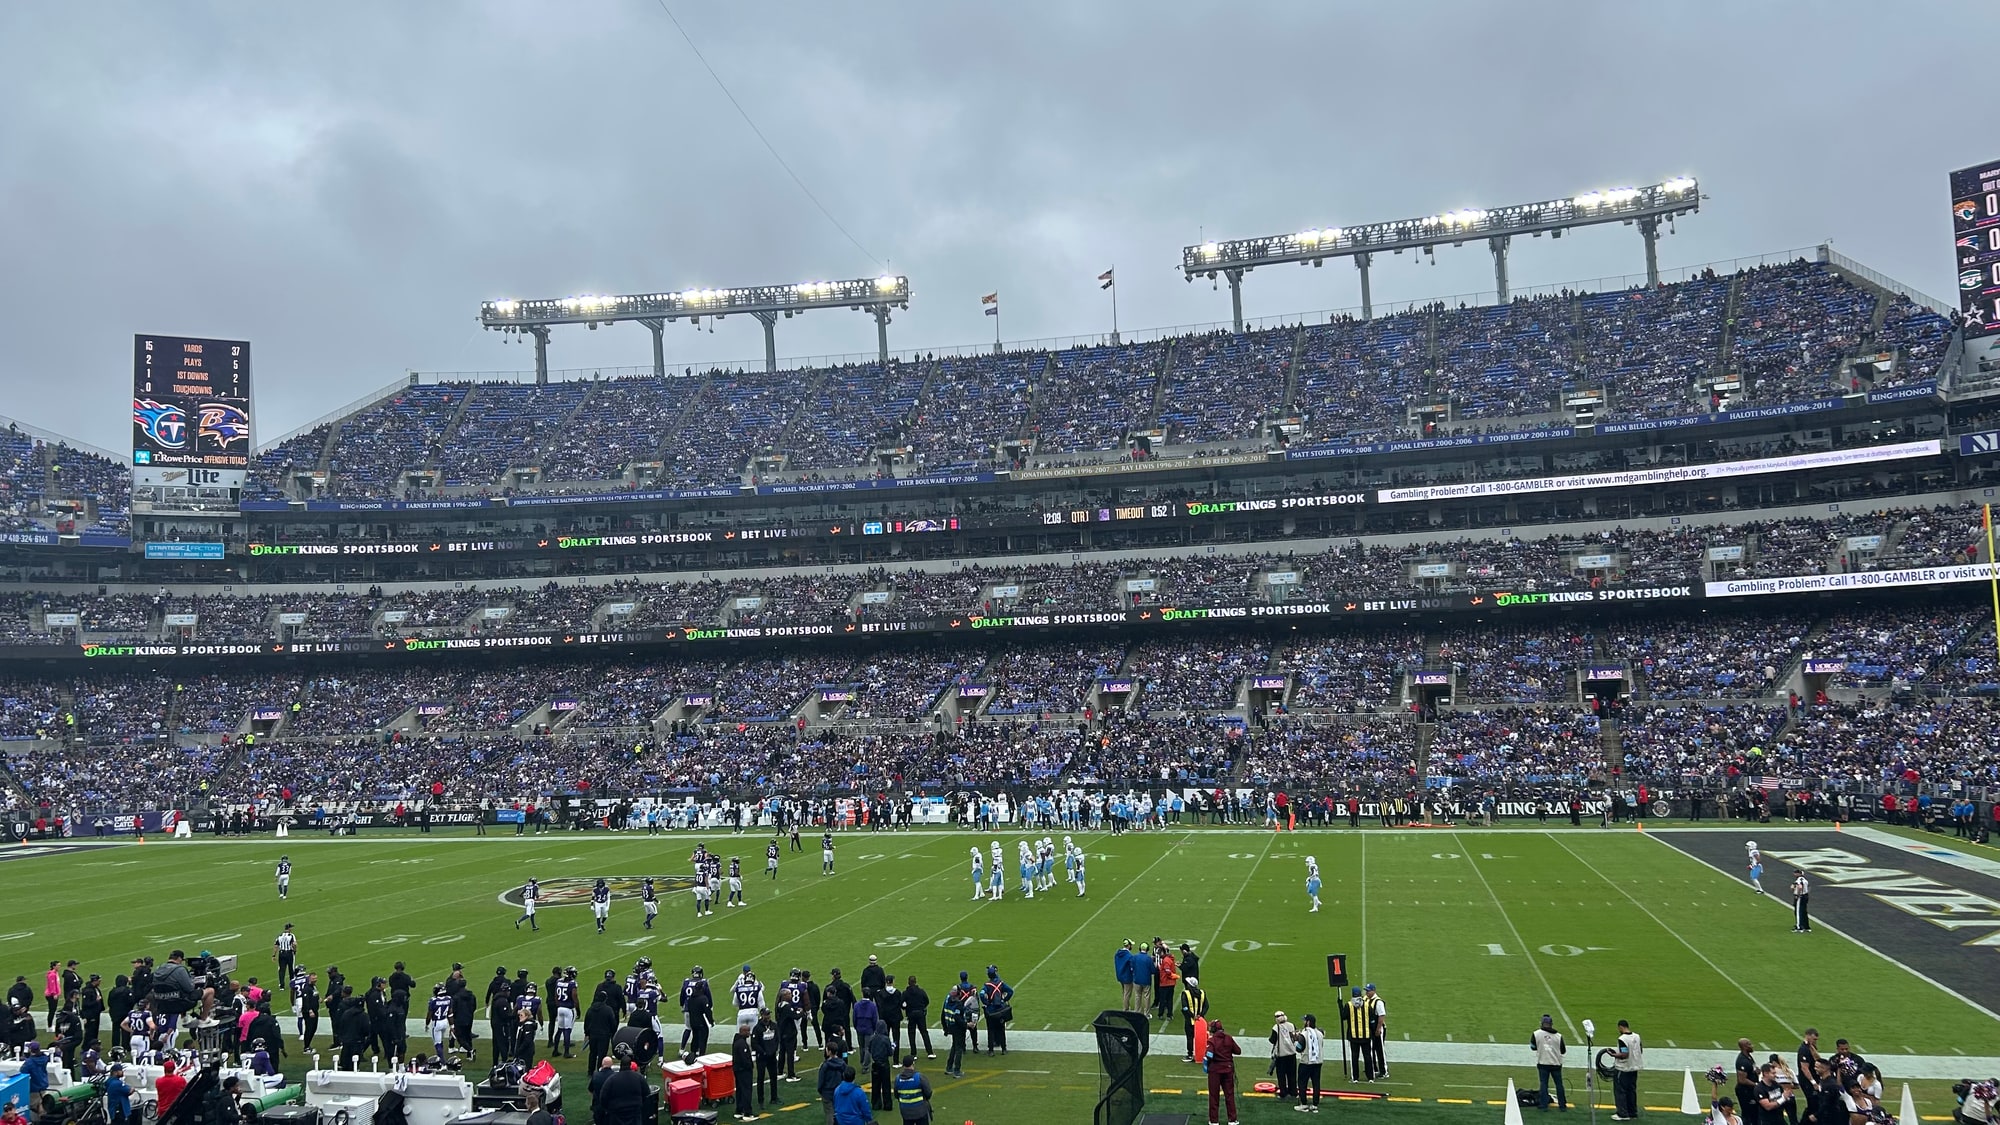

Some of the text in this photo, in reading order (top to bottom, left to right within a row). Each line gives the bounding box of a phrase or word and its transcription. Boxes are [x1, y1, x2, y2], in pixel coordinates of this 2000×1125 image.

[145, 341, 240, 356] 15 YARDS 37
[146, 355, 238, 369] 2 PLAYS 5
[147, 368, 238, 383] 1 1ST DOWNS 2
[146, 382, 238, 397] 0 TOUCHDOWNS 1
[1871, 386, 1933, 402] RING HONOR
[1729, 401, 1833, 420] HALOTI NGATA 2006-2014
[1604, 417, 1699, 433] BRIAN BILLICK 1999-2007
[1488, 429, 1570, 443] TODD HEAP 2001-2010
[1310, 449, 1336, 457] STOVER
[1337, 446, 1372, 455] 1996-2008
[1389, 438, 1473, 451] JAMAL LEWIS 2000-2006
[203, 455, 248, 465] OFFENSIVE TOTALS
[1134, 463, 1155, 471] LEWIS
[1156, 460, 1190, 470] 1996-2012
[186, 468, 220, 486] Lite
[1020, 466, 1110, 479] JONATHAN OGDEN 1996-2007
[798, 484, 824, 492] McCRARY
[912, 477, 946, 485] BOULWARE
[1390, 488, 1429, 500] Gambling
[1430, 486, 1468, 497] Problem?
[1470, 484, 1486, 494] Call
[1488, 479, 1554, 493] 1-800-GAMBLER
[1556, 479, 1566, 487] or
[1567, 475, 1585, 486] visit
[431, 501, 451, 509] BYNER
[452, 500, 482, 508] 1996-2003
[1187, 494, 1365, 515] DRAFTKINGS SPORTSBOOK
[1043, 513, 1062, 524] 12:09
[1115, 506, 1168, 520] TIMEOUT 0:52
[741, 527, 817, 539] BET LIVE NOW
[886, 522, 892, 533] 0
[448, 540, 524, 551] BET LIVE NOW
[559, 532, 712, 548] DRAFTKINGS SPORTSBOOK
[251, 543, 419, 556] DRAFTKINGS SPORTSBOOK
[1727, 581, 1776, 593] Gambling
[1778, 577, 1825, 590] Problem?
[1829, 575, 1848, 587] Call
[1851, 570, 1936, 585] 1-800-GAMBLER
[1939, 570, 1950, 579] or
[1952, 567, 1976, 579] visit
[1497, 586, 1690, 606] DRAFTKINGS SPORTSBOOK
[1163, 603, 1330, 621] DRAFTKINGS SPORTSBOOK
[1364, 601, 1385, 611] BET
[1390, 600, 1417, 610] LIVE
[861, 620, 936, 632] BET LIVE NOW
[971, 613, 1126, 629] DRAFTKINGS SPORTSBOOK
[579, 635, 598, 643] BET
[601, 633, 624, 643] LIVE
[686, 625, 833, 640] DRAFTKINGS SPORTSBOOK
[83, 644, 262, 657] DRAFTKINGS SPORTSBOOK
[291, 643, 311, 652] BET
[315, 643, 340, 652] LIVE
[406, 636, 552, 651] DRAFTKINGS SPORTSBOOK
[430, 813, 447, 822] EXT
[1332, 957, 1342, 975] 1
[557, 987, 568, 1001] 95
[739, 991, 756, 1005] 96
[434, 1005, 450, 1019] 44
